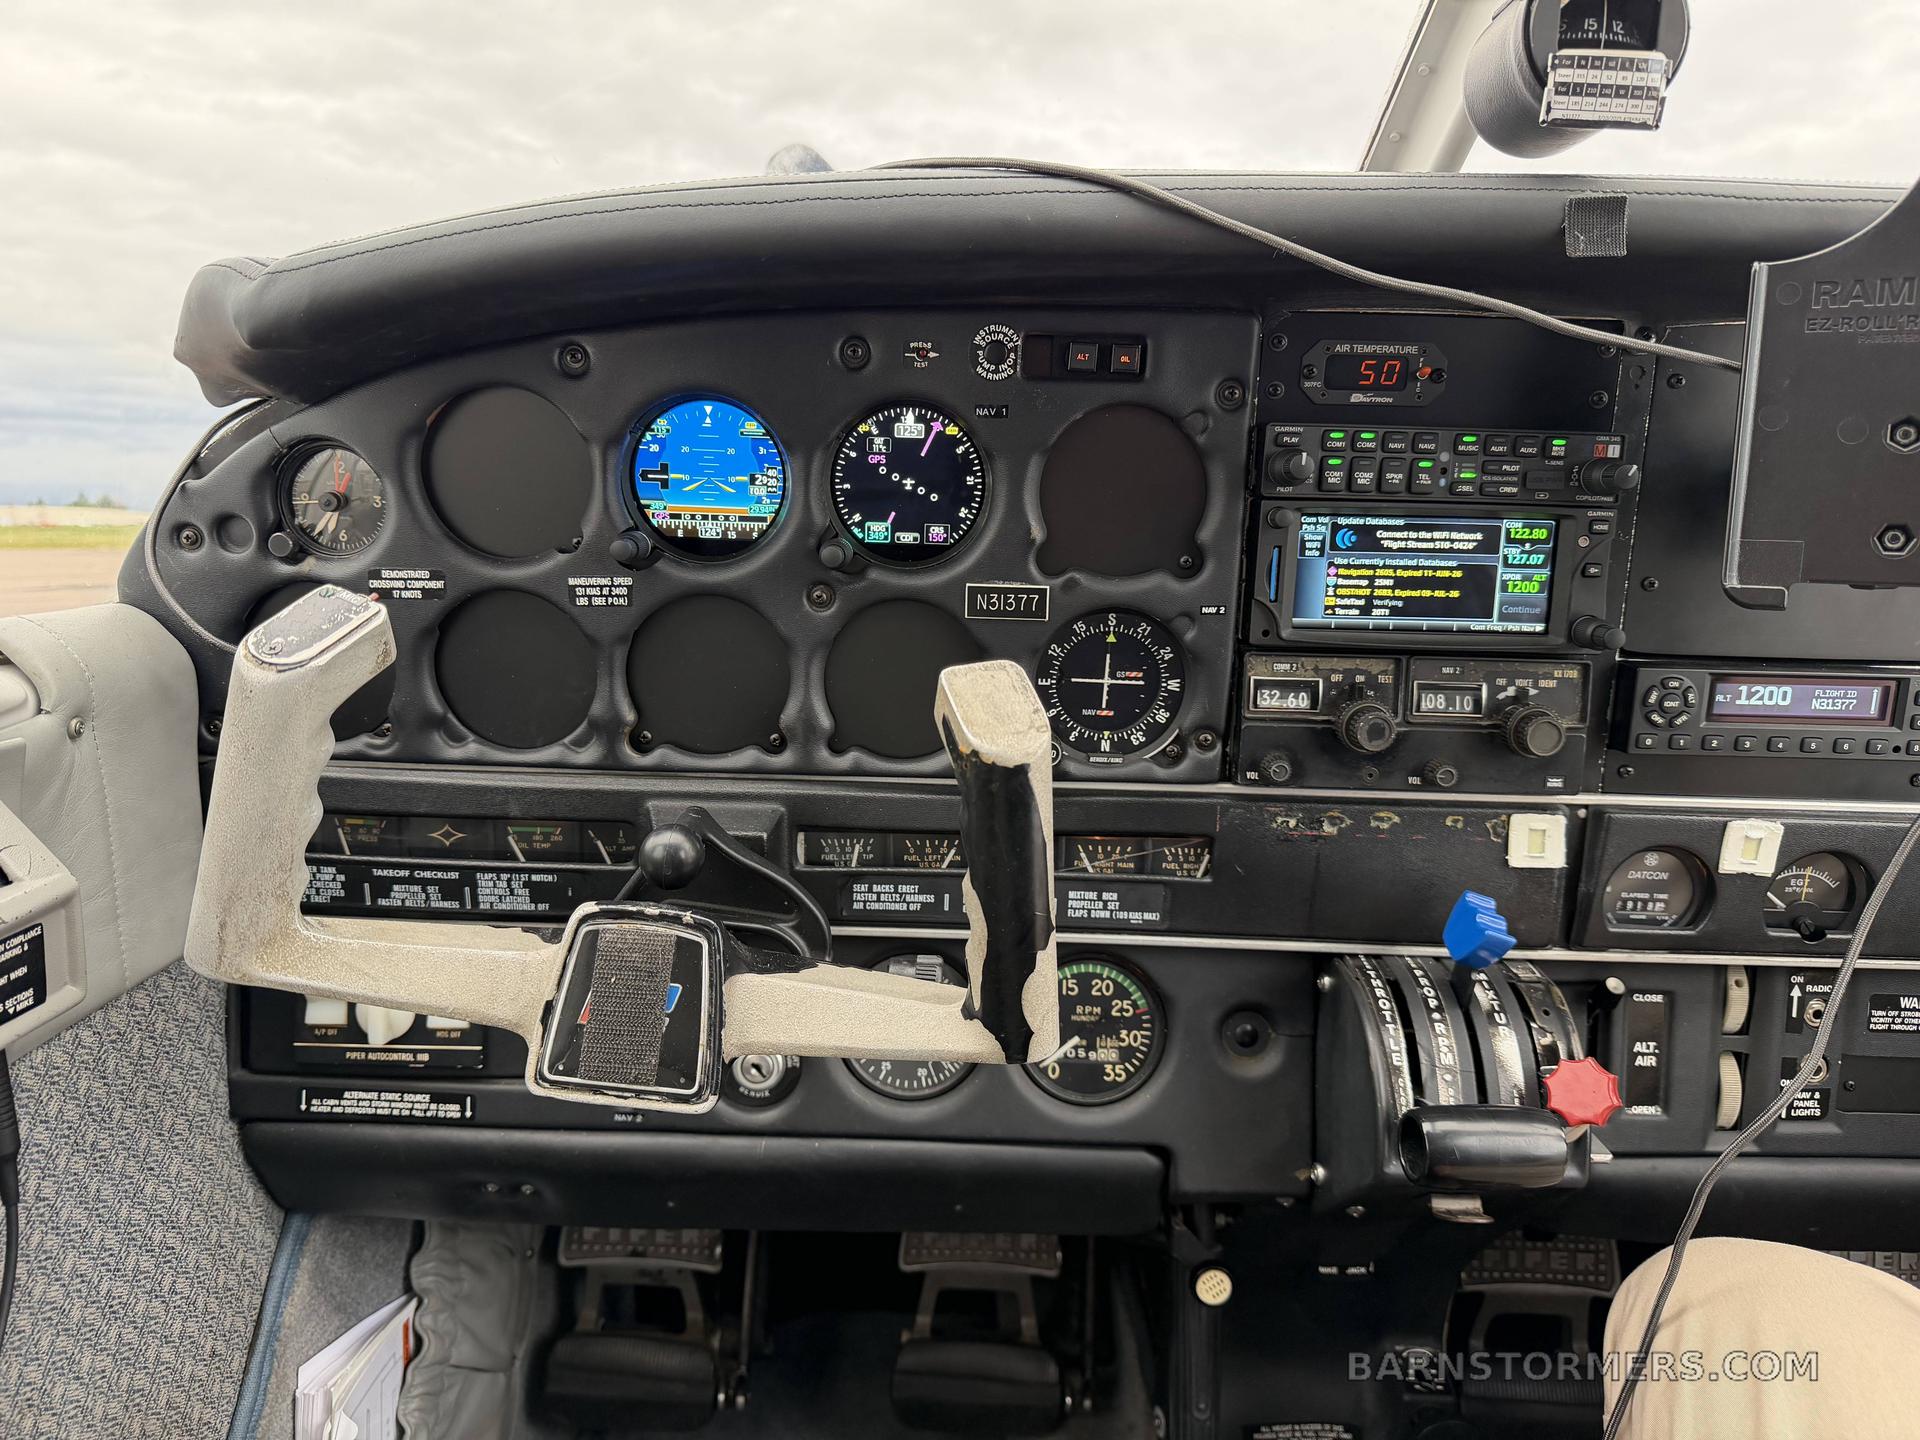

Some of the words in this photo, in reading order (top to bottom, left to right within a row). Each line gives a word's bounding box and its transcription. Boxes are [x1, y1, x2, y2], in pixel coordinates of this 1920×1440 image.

[1584, 18, 1598, 30] 15
[1612, 20, 1625, 34] 12
[1811, 276, 1918, 309] RAM
[974, 324, 1021, 346] INSTRUMENT
[979, 333, 1014, 350] SOURCE
[1334, 344, 1350, 353] AIR
[1352, 344, 1419, 355] TEMPERATURE
[977, 350, 996, 371] PUMP
[998, 352, 1017, 372] INOP
[1076, 353, 1090, 361] ALT
[1120, 355, 1131, 363] OIL
[976, 365, 1015, 381] WARNING
[1359, 360, 1401, 385] 50
[975, 407, 996, 416] NAV
[899, 425, 922, 436] 125°
[868, 455, 886, 464] GPS
[1337, 517, 1364, 526] Update
[1366, 518, 1405, 526] Databases
[1510, 528, 1548, 540] 122.80
[1334, 557, 1347, 565] Use
[1349, 558, 1384, 566] Currently
[1385, 558, 1417, 566] Installed
[1507, 554, 1545, 565] 127.07
[381, 569, 430, 579] DEMONSTRATED
[369, 579, 405, 589] CROSSWIND
[407, 580, 445, 589] COMPONENT
[568, 577, 611, 586] MANEUVERING
[613, 577, 633, 586] SPEED
[611, 587, 628, 596] 3400
[1507, 581, 1540, 593] 1200
[401, 590, 422, 599] KNOTS
[576, 597, 589, 606] LBS
[977, 593, 1039, 612] N31377
[1372, 599, 1403, 607] Verifying
[1202, 606, 1217, 614] NAV
[1502, 605, 1541, 615] Continue
[1072, 621, 1087, 634] 15
[1137, 623, 1152, 636] 21
[1048, 643, 1062, 657] 12
[1160, 646, 1174, 661] 24
[1331, 674, 1344, 682] OFF
[1378, 675, 1393, 684] TEST
[1515, 679, 1534, 687] VOICE
[1538, 679, 1557, 688] IDENT
[1715, 694, 1733, 702] ALT
[1735, 685, 1792, 706] 1200
[1814, 689, 1844, 698] FLIGHT
[1846, 690, 1858, 698] ID
[1420, 693, 1473, 711] 108.10
[1811, 698, 1857, 711] N31377
[1155, 708, 1170, 724] 30
[1131, 731, 1147, 746] 33
[1246, 771, 1259, 780] VOL
[1408, 776, 1421, 785] VOL
[372, 868, 410, 877] TAKEOFF
[414, 870, 460, 879] CHECKLIST
[1627, 870, 1670, 880] DATCON
[392, 885, 422, 893] MIXTURE
[478, 880, 495, 888] TRIM
[853, 884, 870, 892] SEAT
[872, 884, 895, 893] BACKS
[899, 885, 919, 893] ERECT
[391, 892, 426, 900] PROPELLER
[478, 888, 510, 896] CONTROLS
[1068, 891, 1098, 900] MIXTURE
[1102, 892, 1118, 901] RICH
[377, 898, 402, 906] FASTEN
[479, 895, 500, 903] DOORS
[853, 893, 877, 902] FASTEN
[493, 903, 536, 911] CONDITIONER
[537, 903, 550, 911] OFF
[853, 902, 865, 910] AIR
[866, 902, 908, 911] CONDITIONER
[909, 903, 922, 911] OFF
[1068, 900, 1104, 909] PROPELLER
[1107, 901, 1120, 910] SET
[1068, 909, 1088, 918] FLAPS
[1091, 910, 1110, 919] DOWN
[6, 926, 42, 949] COMPLIANCE
[10, 965, 28, 980] WHEN
[1790, 975, 1804, 983] ON
[1062, 979, 1079, 996] 15
[1091, 979, 1114, 996] 20
[6, 988, 34, 1009] SECTIONS
[1633, 994, 1664, 1002] CLOSE
[16, 997, 34, 1012] MIKE
[1111, 1000, 1134, 1017] 25
[1076, 1005, 1101, 1015] RPM
[1366, 970, 1402, 1066] THROTTLE
[1119, 1030, 1141, 1047] 30
[346, 1051, 366, 1060] PIPER
[368, 1052, 415, 1061] AUTOCONTROL
[881, 1062, 892, 1071] 25
[1634, 1056, 1658, 1067] AIR
[917, 1067, 928, 1077] 20
[1103, 1064, 1127, 1082] 35
[343, 1091, 379, 1100] ALTERNATE
[380, 1092, 402, 1101] STATIC
[403, 1093, 431, 1102] SOURCE
[1793, 1100, 1820, 1108] PANEL
[1631, 1105, 1657, 1114] OPEN
[1791, 1108, 1821, 1117] LIGHTS
